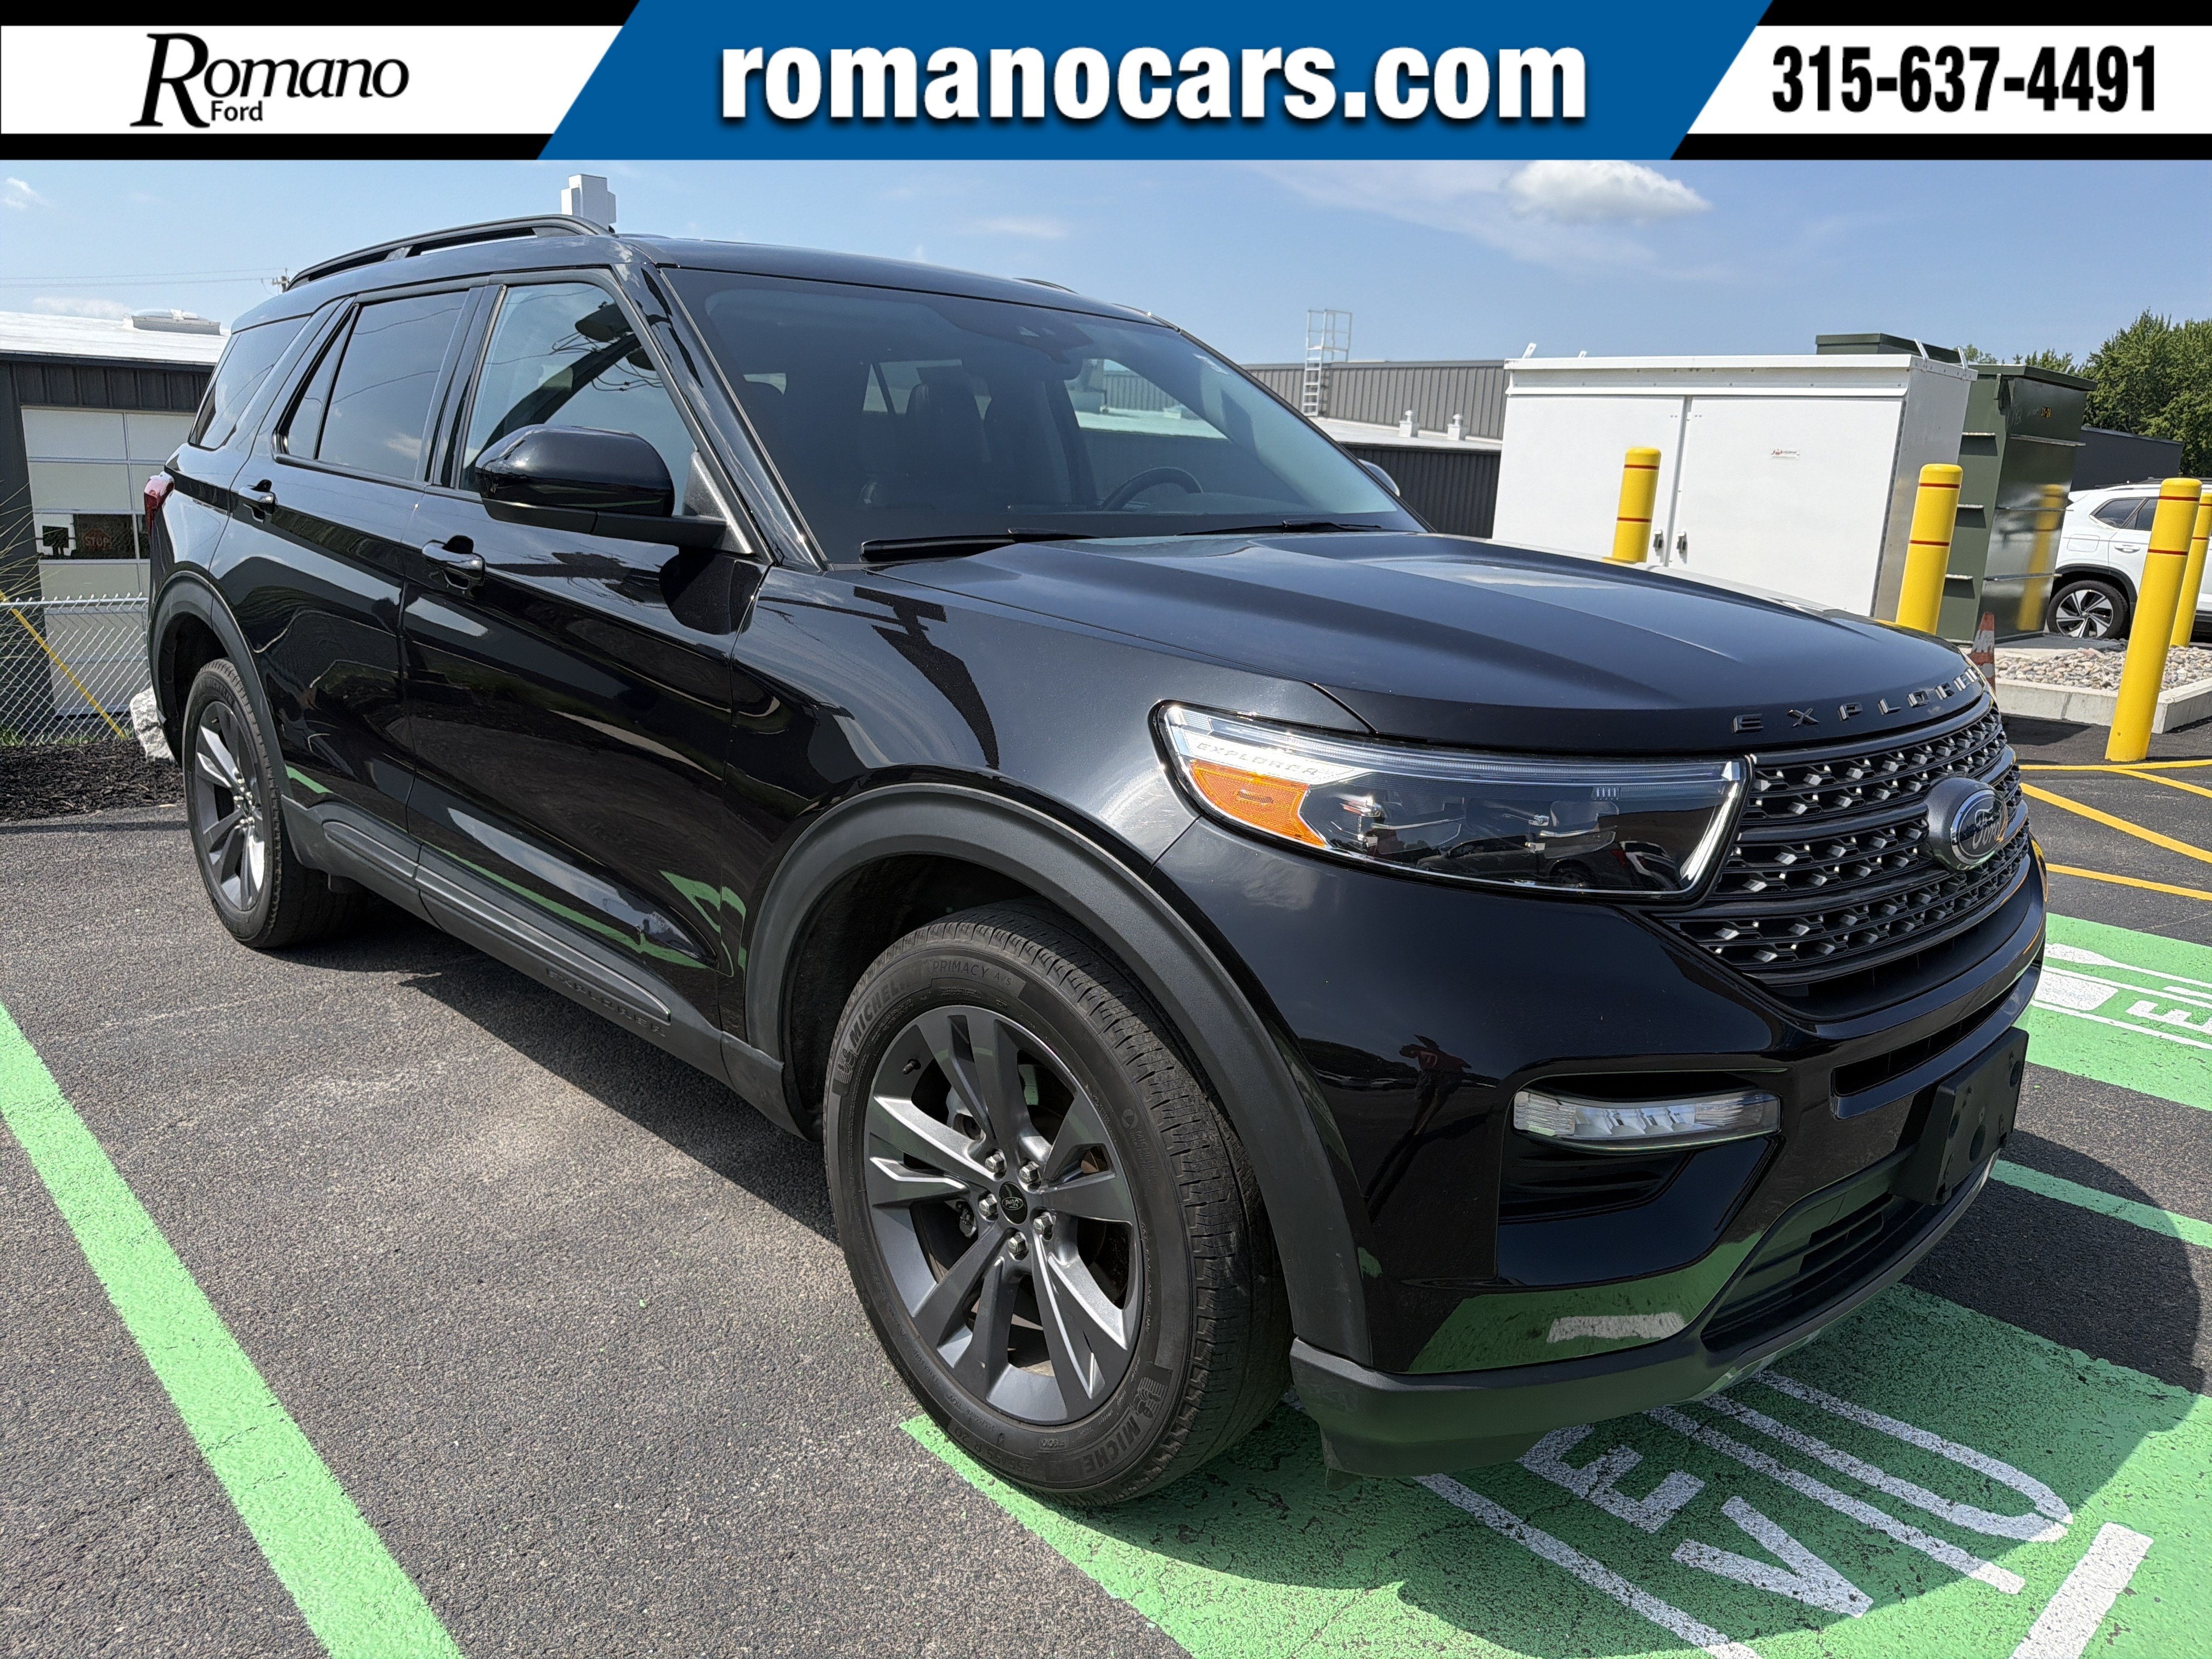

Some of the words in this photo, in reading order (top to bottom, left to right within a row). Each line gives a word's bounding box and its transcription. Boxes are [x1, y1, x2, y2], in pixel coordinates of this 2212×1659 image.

[84, 536, 110, 547] STOP
[1197, 742, 1318, 775] EXPLORER
[932, 961, 990, 979] PRIMACY
[994, 972, 1012, 987] A/S
[850, 970, 917, 1050] MICHEL
[1005, 1199, 1019, 1209] Ford
[954, 1427, 970, 1444] 20
[1077, 1414, 1141, 1474] MICHE
[1516, 1423, 1874, 1618] EV
